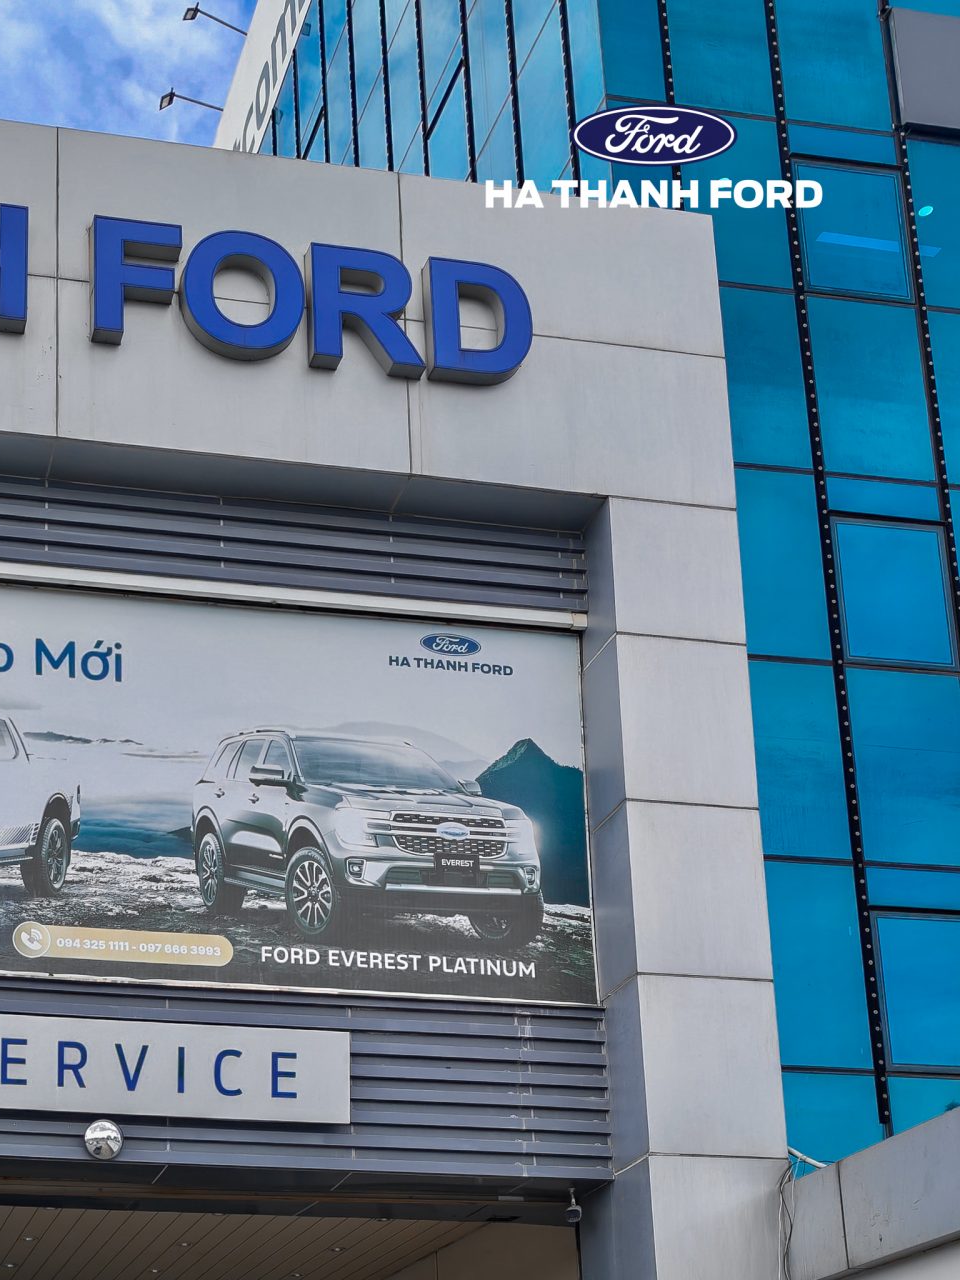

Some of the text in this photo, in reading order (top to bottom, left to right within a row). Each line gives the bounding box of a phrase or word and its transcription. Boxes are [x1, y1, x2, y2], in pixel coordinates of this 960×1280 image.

[90, 215, 534, 386] FORD
[432, 637, 469, 653] Ford
[35, 637, 123, 683] Mới
[388, 655, 514, 676] HA THANH FORD
[441, 858, 475, 868] EVEREST
[56, 937, 81, 949] 094
[83, 939, 106, 950] 325
[108, 940, 130, 952] 1111
[139, 943, 163, 954] 097
[190, 945, 221, 957] 3993
[261, 946, 537, 979] FORD EVEREST PLATINUM
